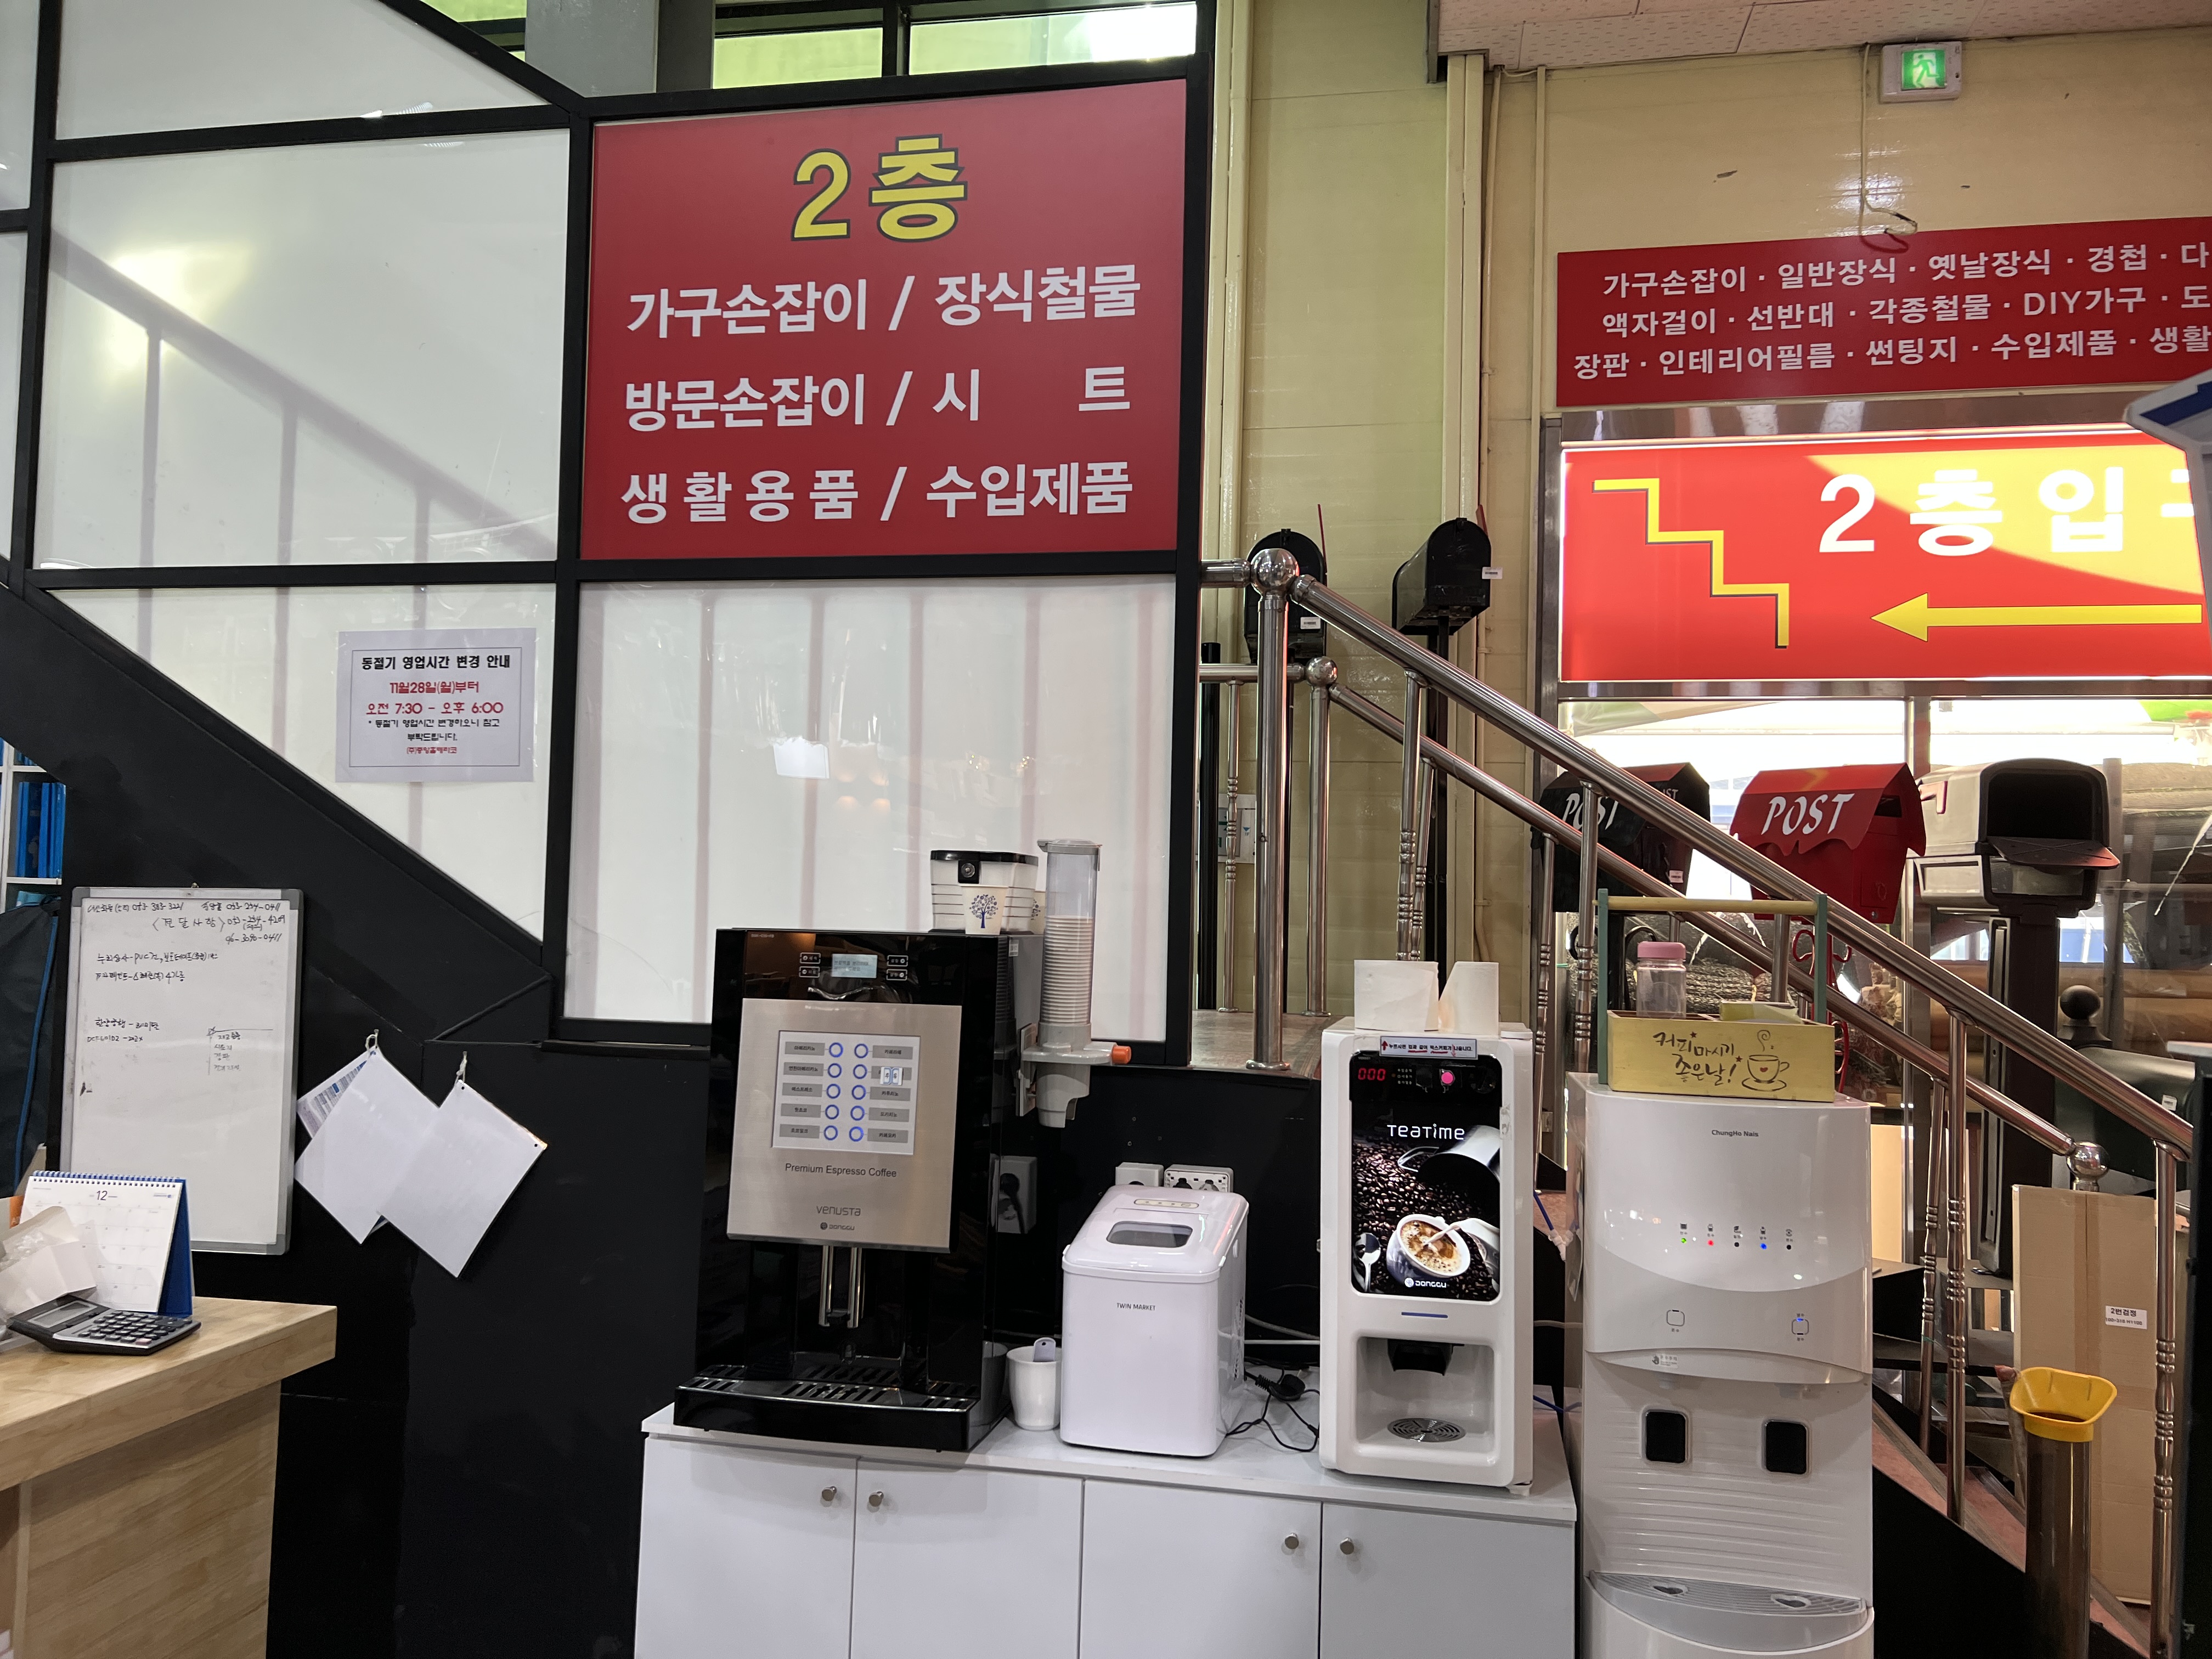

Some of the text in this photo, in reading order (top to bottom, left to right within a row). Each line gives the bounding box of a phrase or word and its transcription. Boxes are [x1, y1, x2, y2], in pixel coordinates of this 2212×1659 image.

[1603, 241, 2210, 298] 가구손잡이 일반장식 옛날장식 경첩 다
[627, 278, 867, 338] 가구손잡이
[934, 263, 1141, 326] 장식철물
[1602, 285, 2211, 338] 액자걸이 선반대 각종철물 DIY가구 도
[1573, 325, 2210, 380] 장판 인테리어필름 썬팅지 수입제품 생활
[625, 373, 865, 432] 방문손잡이
[926, 461, 1133, 518] 수입제품
[362, 654, 510, 670] 동절기 영업시간 변경 안내
[366, 703, 389, 715] 오전
[394, 703, 422, 714] 7:30
[441, 702, 465, 714] 오후
[471, 702, 504, 714] 6:00
[375, 719, 500, 728] 동절기 영업시간 변경하오니 참고
[1761, 793, 1856, 836] POST
[1653, 1032, 1734, 1057] 커피 마시기
[785, 1163, 897, 1178] Premium Espresso Coffee
[97, 1190, 108, 1201] 12
